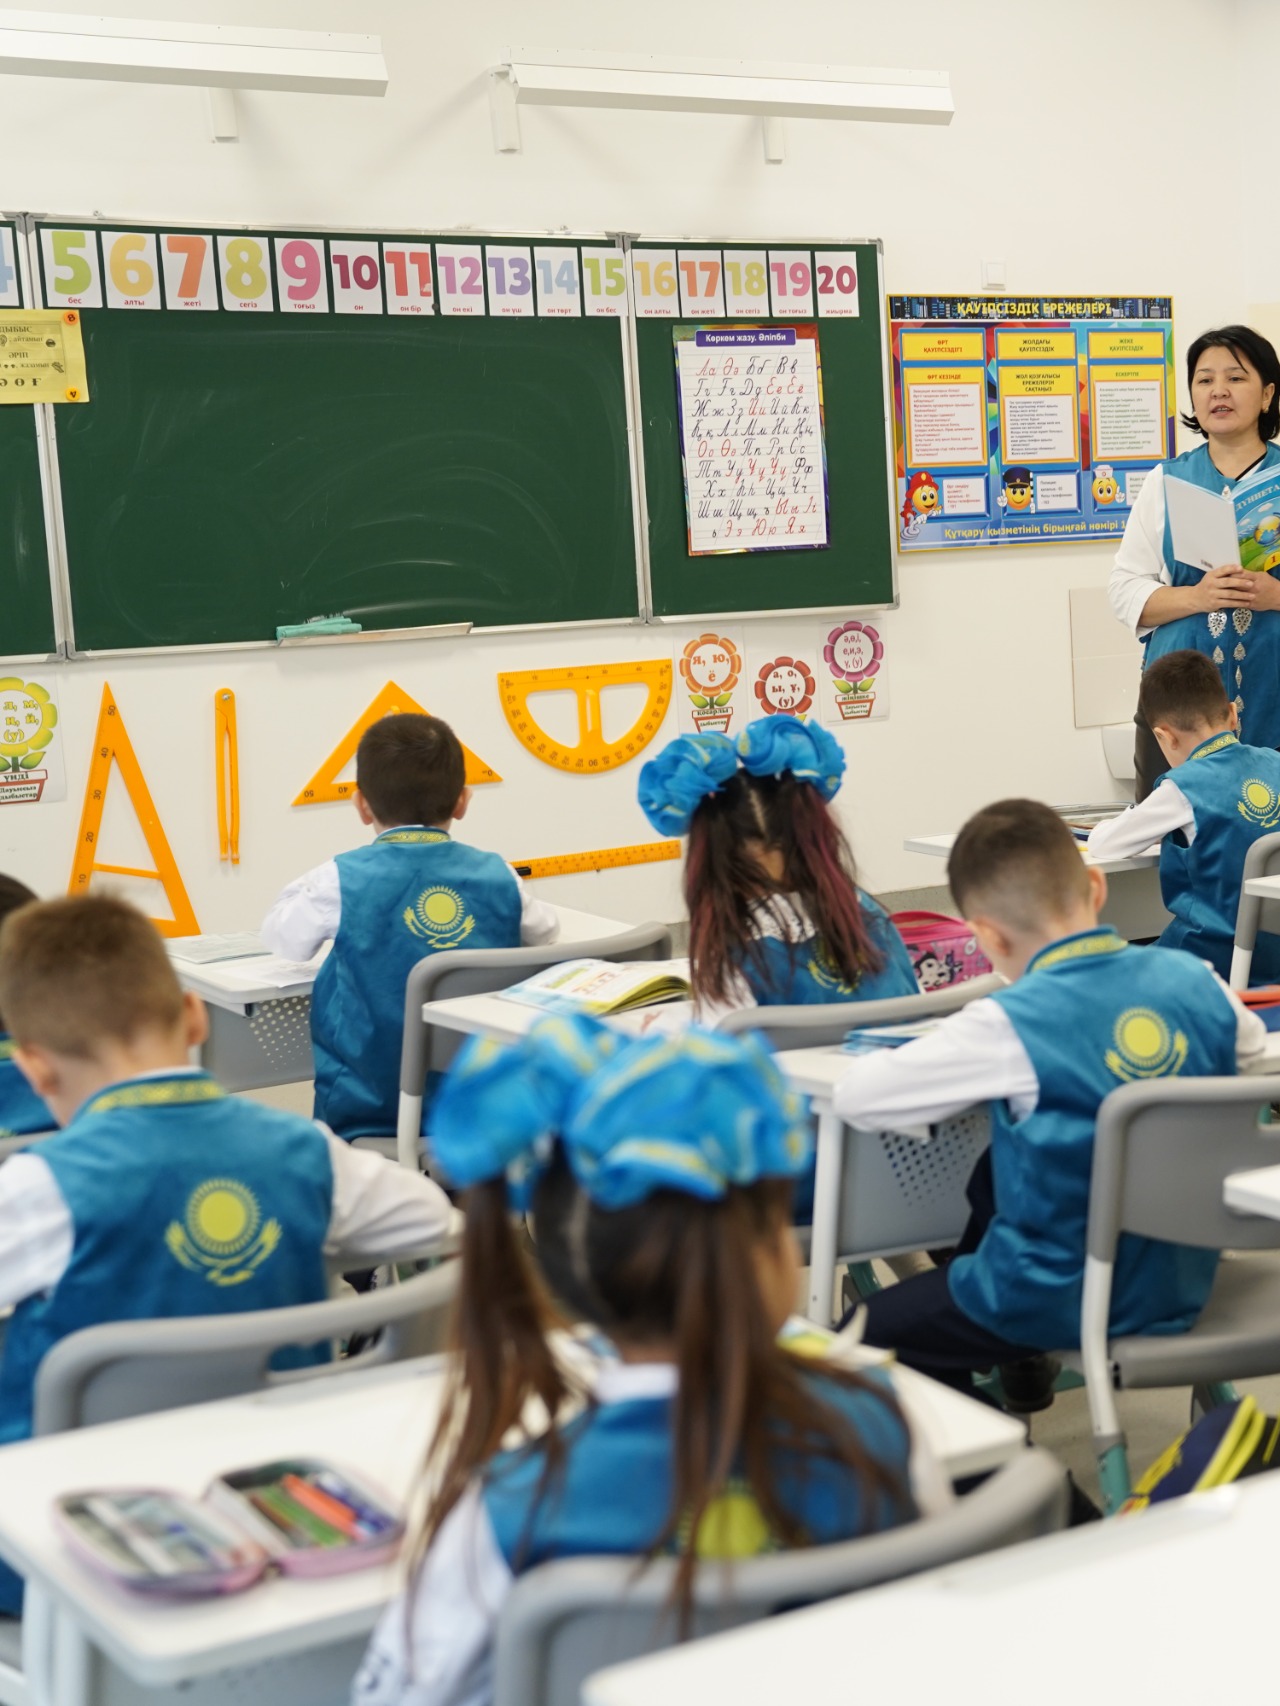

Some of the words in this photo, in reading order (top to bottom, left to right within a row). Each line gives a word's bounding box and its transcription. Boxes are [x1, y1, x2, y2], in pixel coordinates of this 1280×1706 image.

[51, 230, 92, 295] 5
[109, 234, 154, 297] 6
[166, 236, 207, 298] 7
[225, 238, 268, 300] 8
[281, 240, 321, 301] 9
[332, 254, 379, 290] 10
[385, 251, 432, 297] 11
[438, 256, 483, 295] 12
[488, 257, 531, 296] 13
[536, 259, 578, 295] 14
[584, 258, 625, 296] 15
[634, 261, 677, 297] 16
[680, 261, 720, 297] 17
[726, 262, 767, 296] 18
[770, 262, 811, 297] 19
[817, 265, 857, 294] 20
[67, 296, 82, 304] бес
[957, 302, 1039, 315] ҚАУІПСІЗДІК
[1043, 302, 1111, 315] ЕРЕЖЕЛЕРІ
[705, 333, 735, 343] Көркем
[736, 334, 757, 343] жазу.
[758, 332, 787, 342] Әліпби
[944, 528, 984, 539] Құтқару
[987, 524, 1040, 536] қызметінің
[1043, 521, 1086, 534] бірыңғай
[1089, 520, 1118, 531] нөмірі
[1271, 555, 1276, 564] 1
[108, 705, 117, 716] 50
[101, 747, 109, 758] 40
[93, 789, 101, 800] 30
[86, 831, 94, 842] 20
[79, 873, 86, 883] 10
